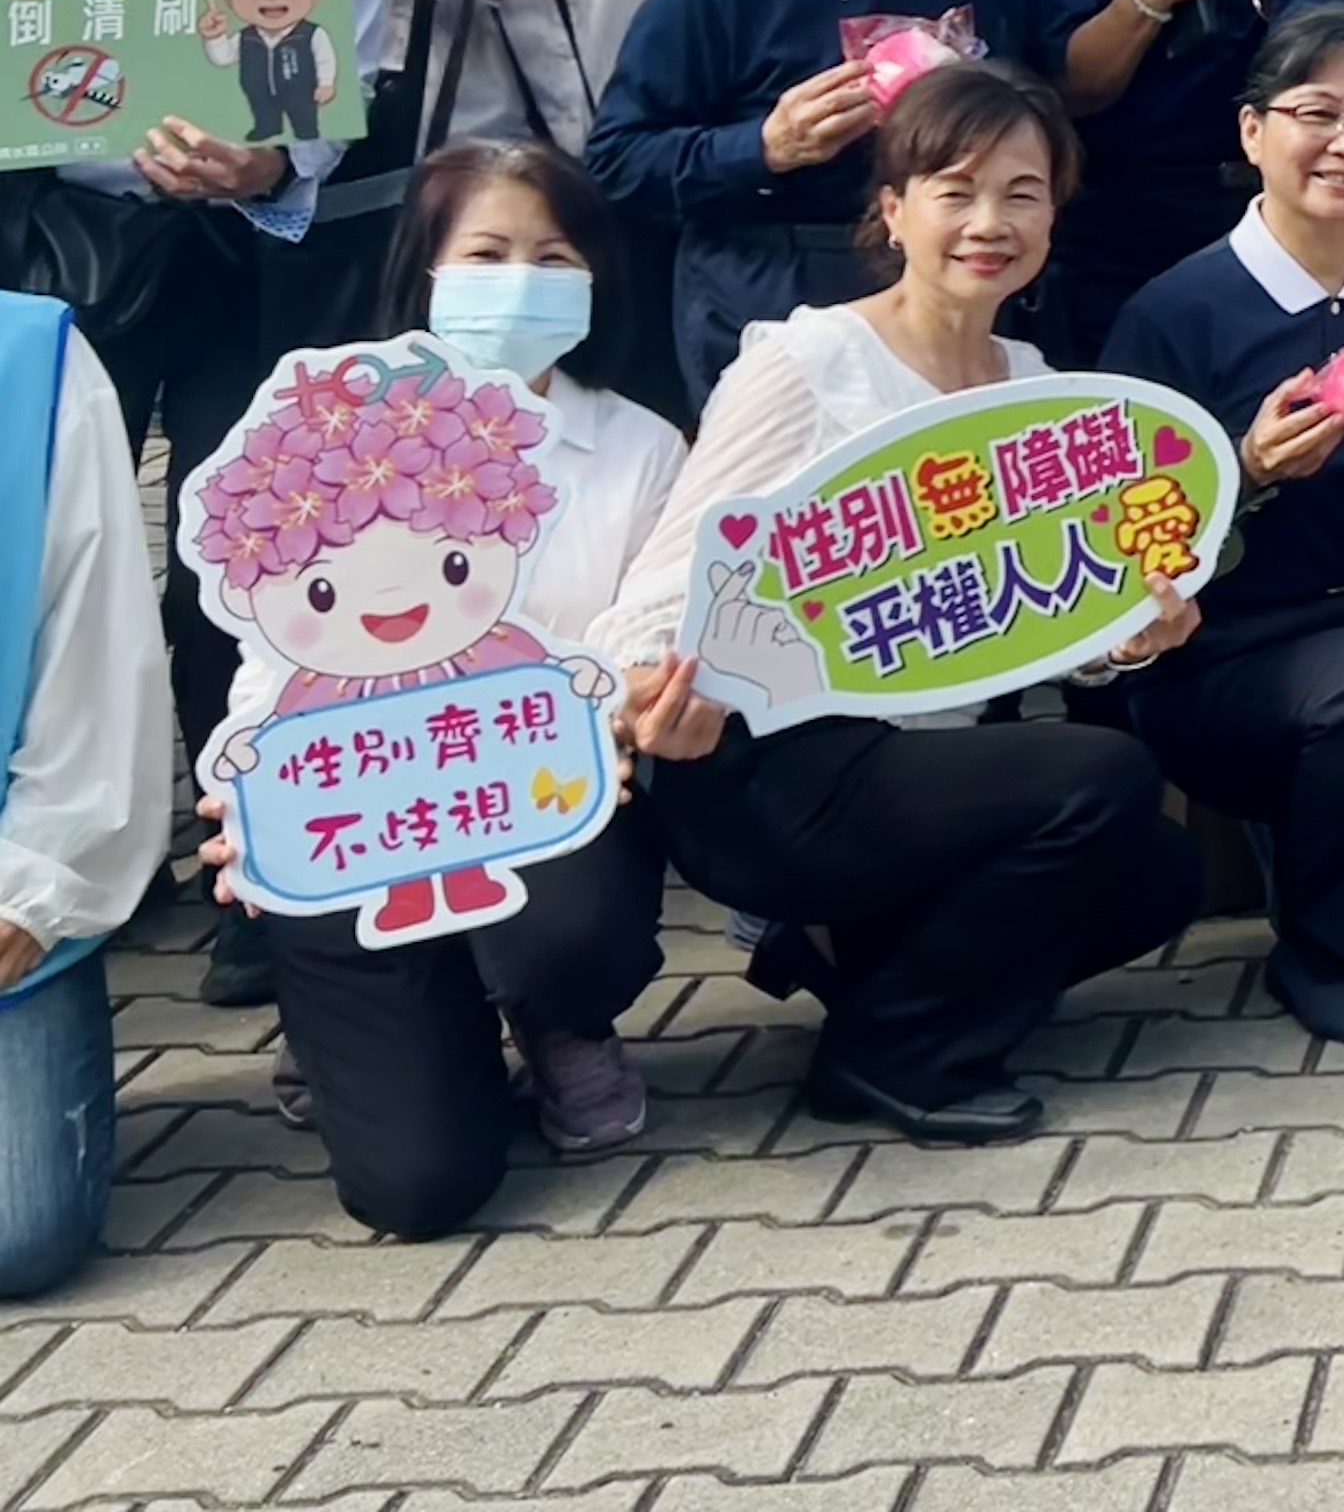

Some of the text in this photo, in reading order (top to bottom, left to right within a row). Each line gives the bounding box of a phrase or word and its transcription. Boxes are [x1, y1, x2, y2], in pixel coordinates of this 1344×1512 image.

[8, 0, 52, 47] 倒
[278, 690, 560, 790] 性別齊視
[303, 781, 515, 871] 不歧視
